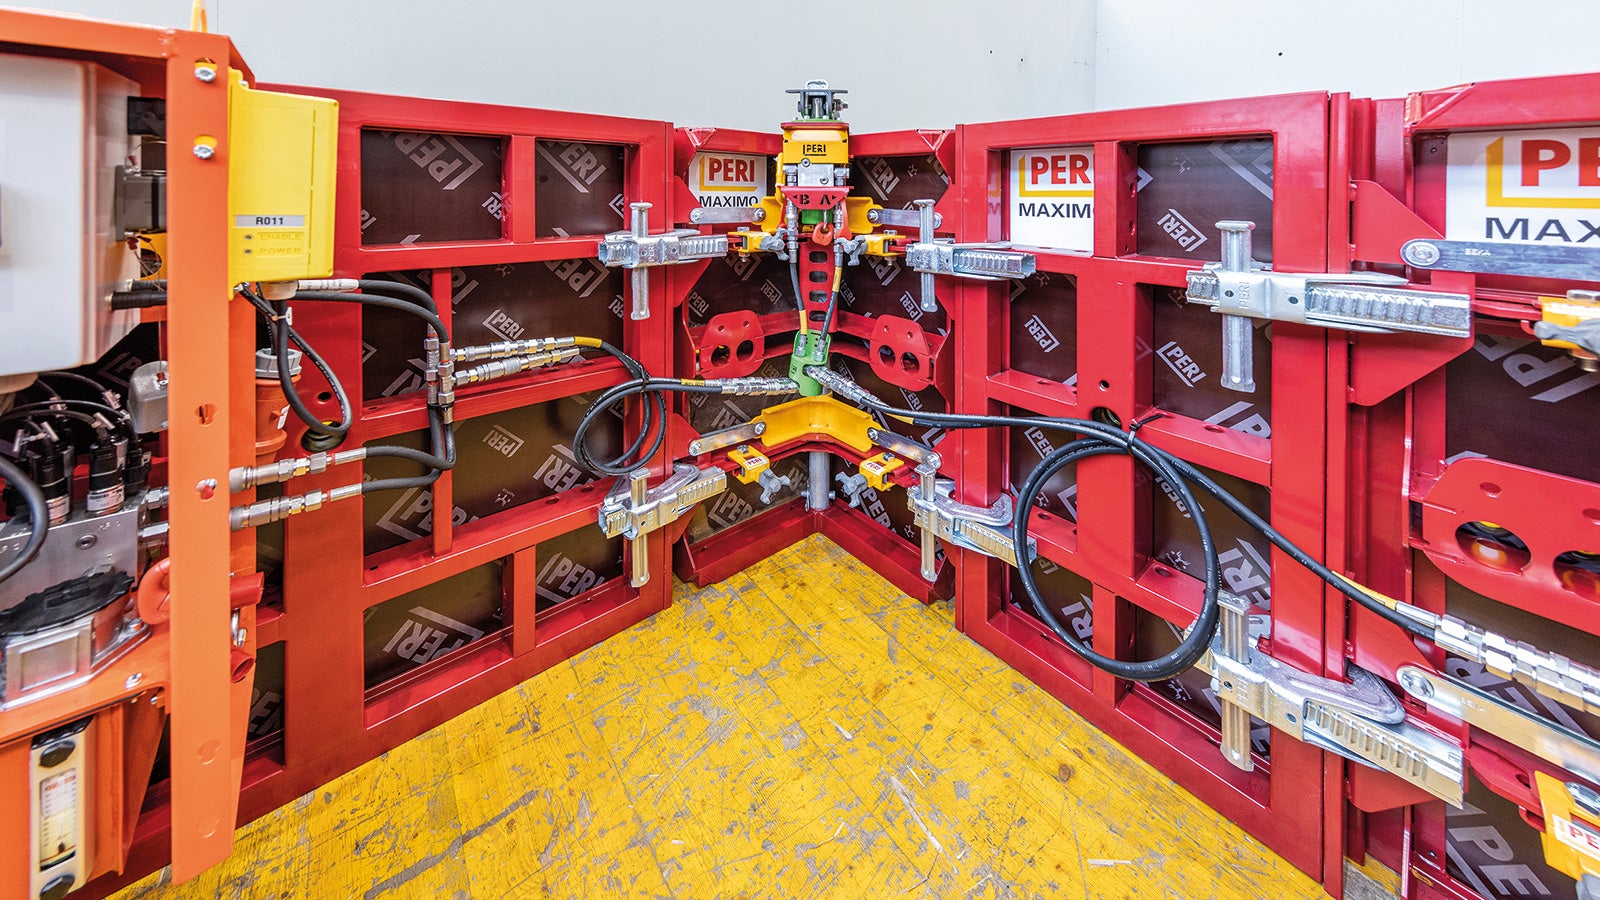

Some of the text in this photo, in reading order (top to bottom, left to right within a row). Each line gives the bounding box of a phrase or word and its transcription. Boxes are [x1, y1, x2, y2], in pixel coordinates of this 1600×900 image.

[806, 144, 826, 153] PERI
[709, 158, 755, 183] PERI
[800, 194, 831, 205] B A
[255, 216, 284, 226] R011
[1157, 213, 1197, 248] PERI
[259, 233, 301, 241] ENABLE
[259, 247, 302, 255] POWER
[689, 292, 710, 314] PERI
[900, 294, 919, 319] PERI
[492, 312, 525, 340] PERI
[1024, 318, 1053, 349] PERI
[1166, 346, 1207, 383] PERI
[482, 429, 513, 457] PERI
[866, 462, 881, 471] PERI
